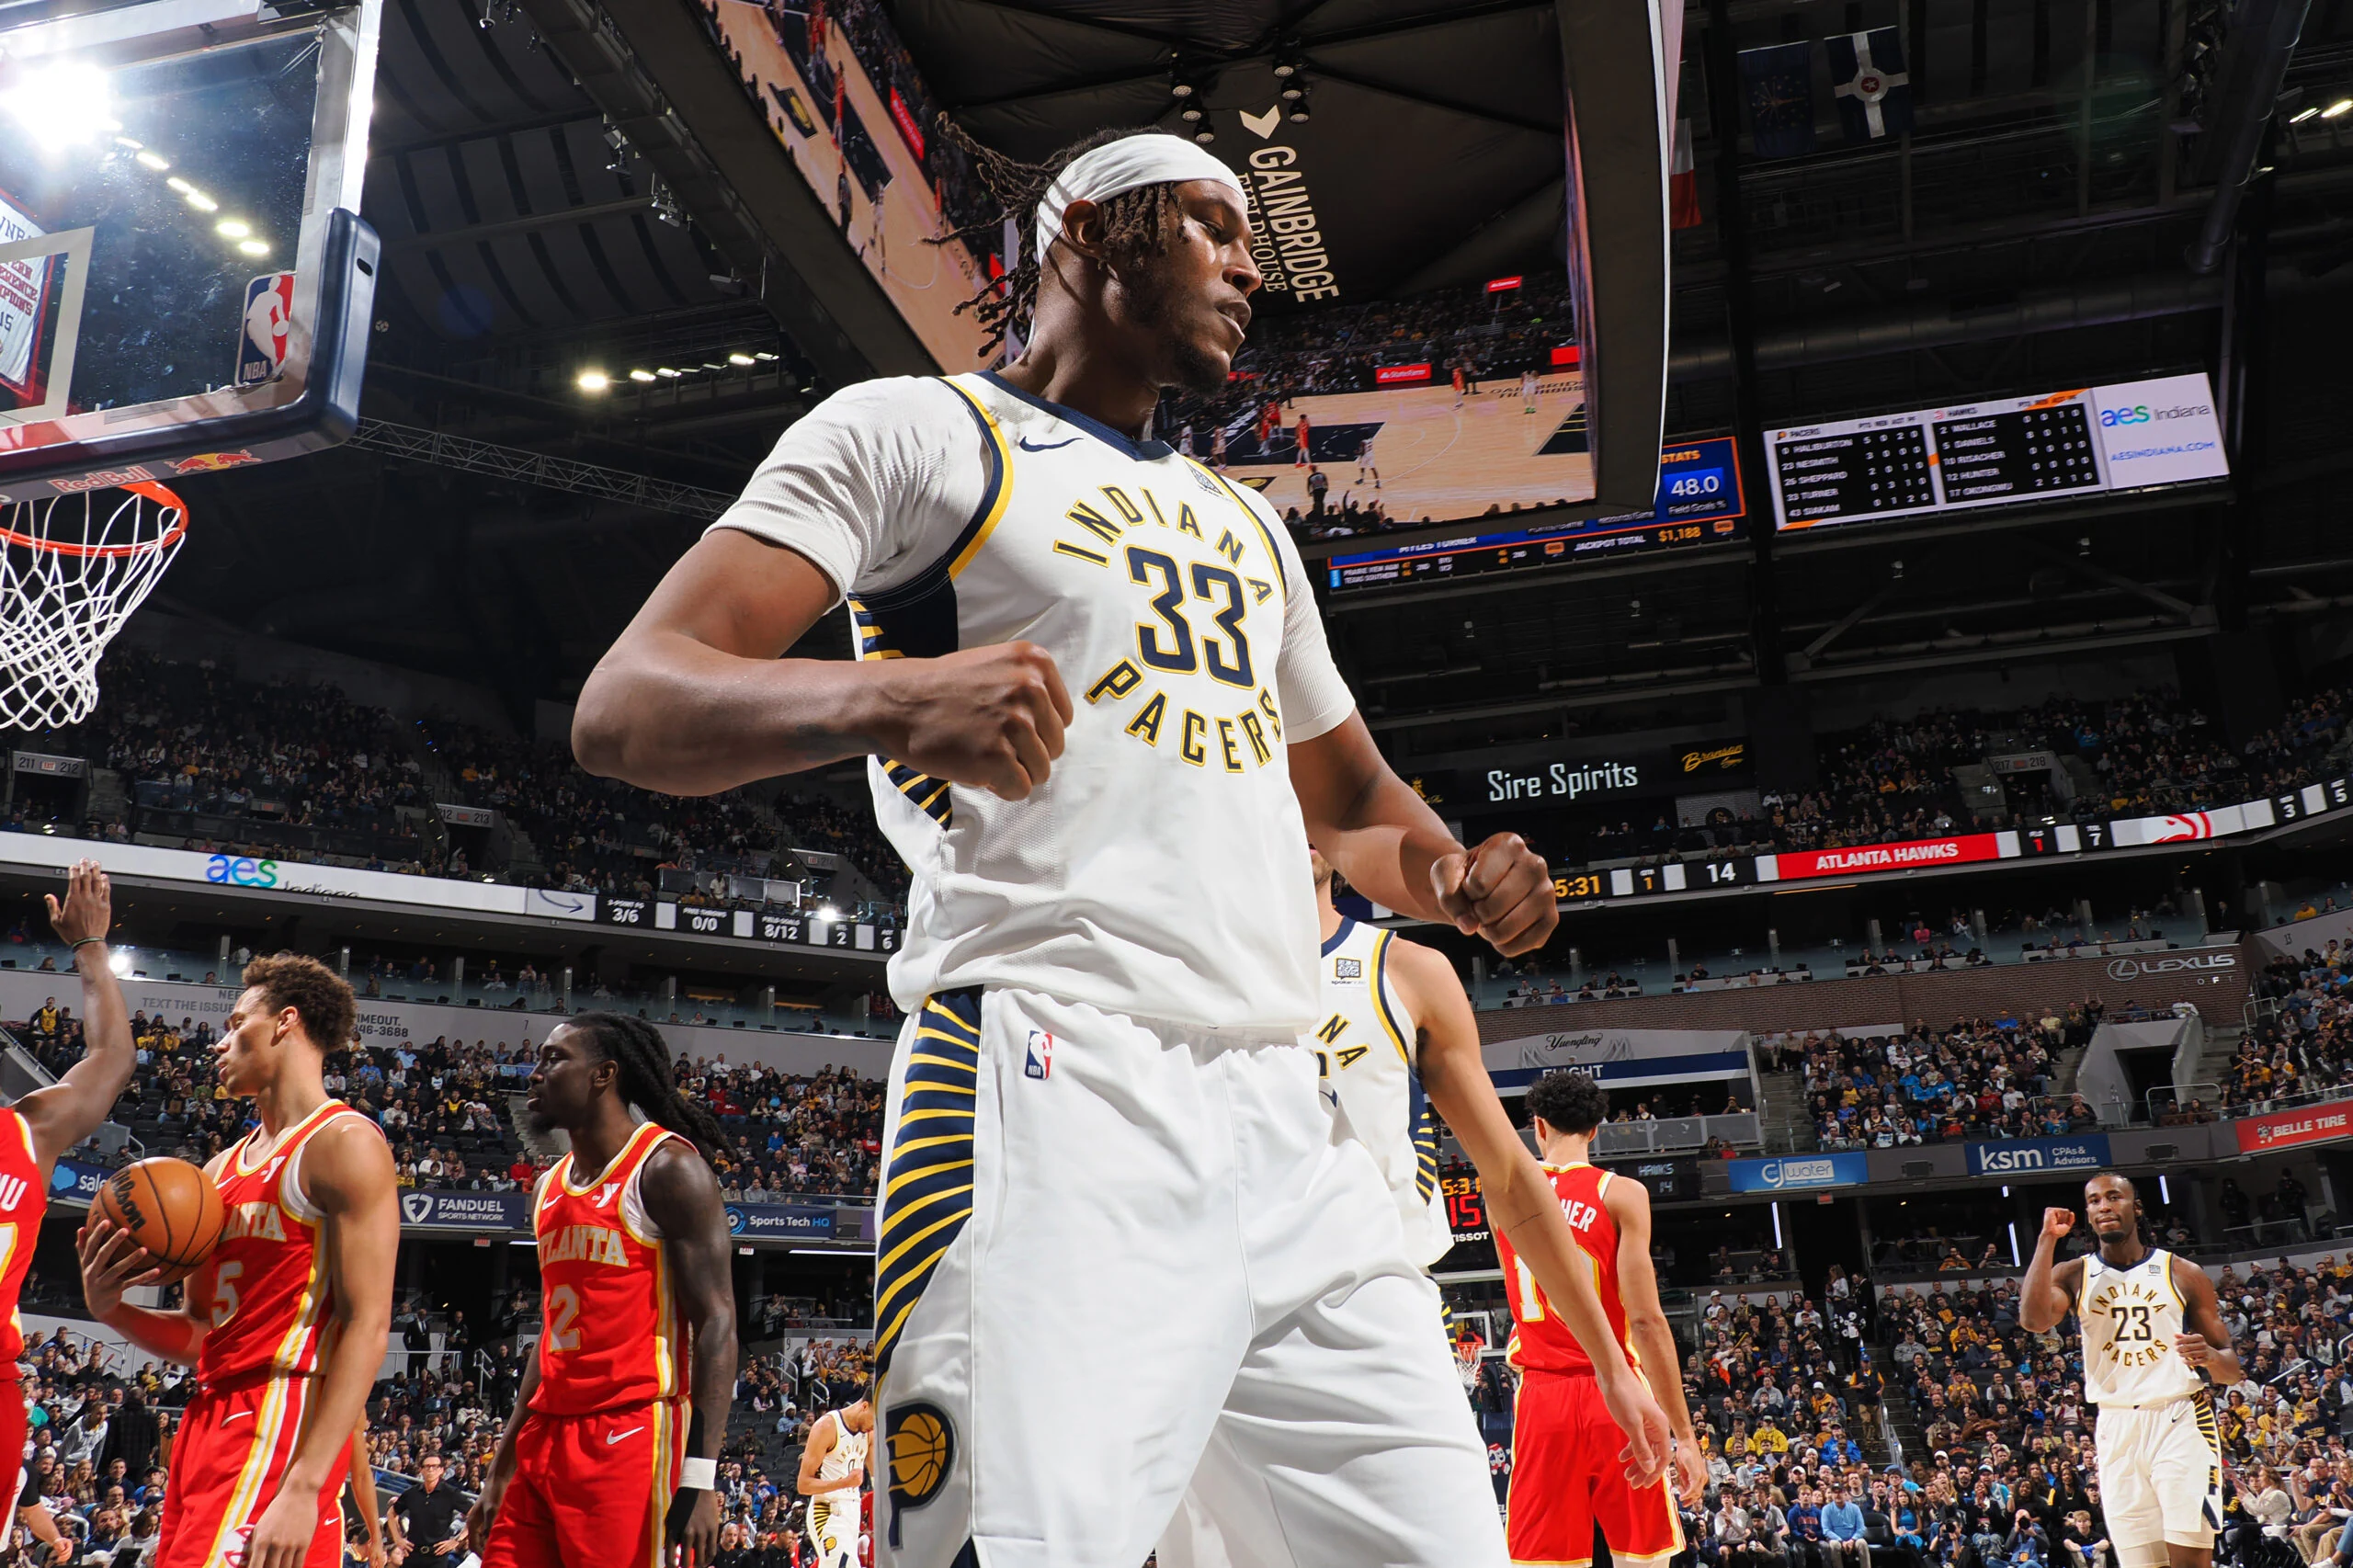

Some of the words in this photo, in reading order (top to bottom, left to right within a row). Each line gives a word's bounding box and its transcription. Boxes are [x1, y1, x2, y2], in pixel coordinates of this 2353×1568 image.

[1249, 145, 1340, 303] GAINBRIDGE
[243, 361, 267, 381] NBA
[2100, 405, 2150, 427] aes
[2154, 404, 2211, 421] Indiana
[1951, 420, 1997, 432] WALLACE
[1896, 432, 1904, 440] 2
[1661, 449, 1700, 464] STATS
[1882, 449, 1891, 458] 0
[97, 465, 156, 486] Bull
[1960, 468, 2000, 480] HUNTER
[2052, 476, 2061, 484] 2
[1670, 475, 1720, 496] 48.0
[1887, 481, 1895, 489] 3
[1918, 477, 1927, 485] 0
[1873, 498, 1881, 506] 0
[1907, 494, 1915, 503] 2
[1921, 493, 1928, 501] 0
[1668, 505, 1691, 516] Field
[1691, 501, 1715, 513] Goals
[1052, 483, 1275, 607] INDIANA
[1574, 538, 1616, 551] JACKPOT
[1617, 534, 1646, 548] TOTAL
[1122, 543, 1257, 690] 33
[1084, 656, 1282, 774] PACERS
[18, 756, 35, 769] 211
[60, 762, 78, 774] 212
[2029, 756, 2046, 767] 218
[1487, 769, 1541, 802] Sire
[1550, 761, 1639, 800] Spirits
[2335, 788, 2347, 803] 5
[2283, 803, 2296, 818] 3
[2032, 837, 2043, 852] 1
[2088, 832, 2101, 846] 7
[1816, 848, 1893, 870] ATLANTA
[1893, 843, 1959, 862] HAWKS
[207, 854, 278, 888] aes
[1706, 862, 1736, 883] 14
[1554, 875, 1601, 898] 5:31
[1643, 876, 1654, 891] 1
[612, 907, 640, 924] 3/6
[691, 916, 718, 931] 0/0
[764, 924, 798, 940] 8/12
[836, 931, 847, 946] 2
[881, 937, 892, 949] 6
[2142, 954, 2236, 972] LEXUS
[219, 989, 242, 1000] NEE
[142, 997, 173, 1010] TEXT
[175, 1000, 196, 1011] THE
[199, 1001, 233, 1013] ISSUE
[356, 1013, 402, 1026] IMEOUT.
[1545, 1032, 1603, 1051] Yuengling
[1028, 1064, 1041, 1076] NBA
[2272, 1119, 2313, 1138] BELLE
[2315, 1113, 2347, 1130] TIRE
[1979, 1144, 2043, 1171] ksm
[2053, 1155, 2097, 1165] Advisors
[1638, 1163, 1674, 1176] HAWKS
[1786, 1165, 1831, 1177] water
[1441, 1177, 1481, 1196] 5:31
[438, 1198, 505, 1212] FANDUEL
[1449, 1194, 1482, 1228] 15
[220, 1201, 287, 1243] ANTA
[438, 1211, 468, 1221] SPORTS
[468, 1212, 505, 1221] NETWORK
[749, 1215, 785, 1228] Sports
[786, 1216, 811, 1227] Tech
[812, 1218, 830, 1227] HQ
[211, 1260, 244, 1329] 5
[2091, 1281, 2167, 1316] INDIANA
[550, 1283, 581, 1352] 2
[2110, 1305, 2152, 1342] 23
[2102, 1339, 2168, 1367] PACERS
